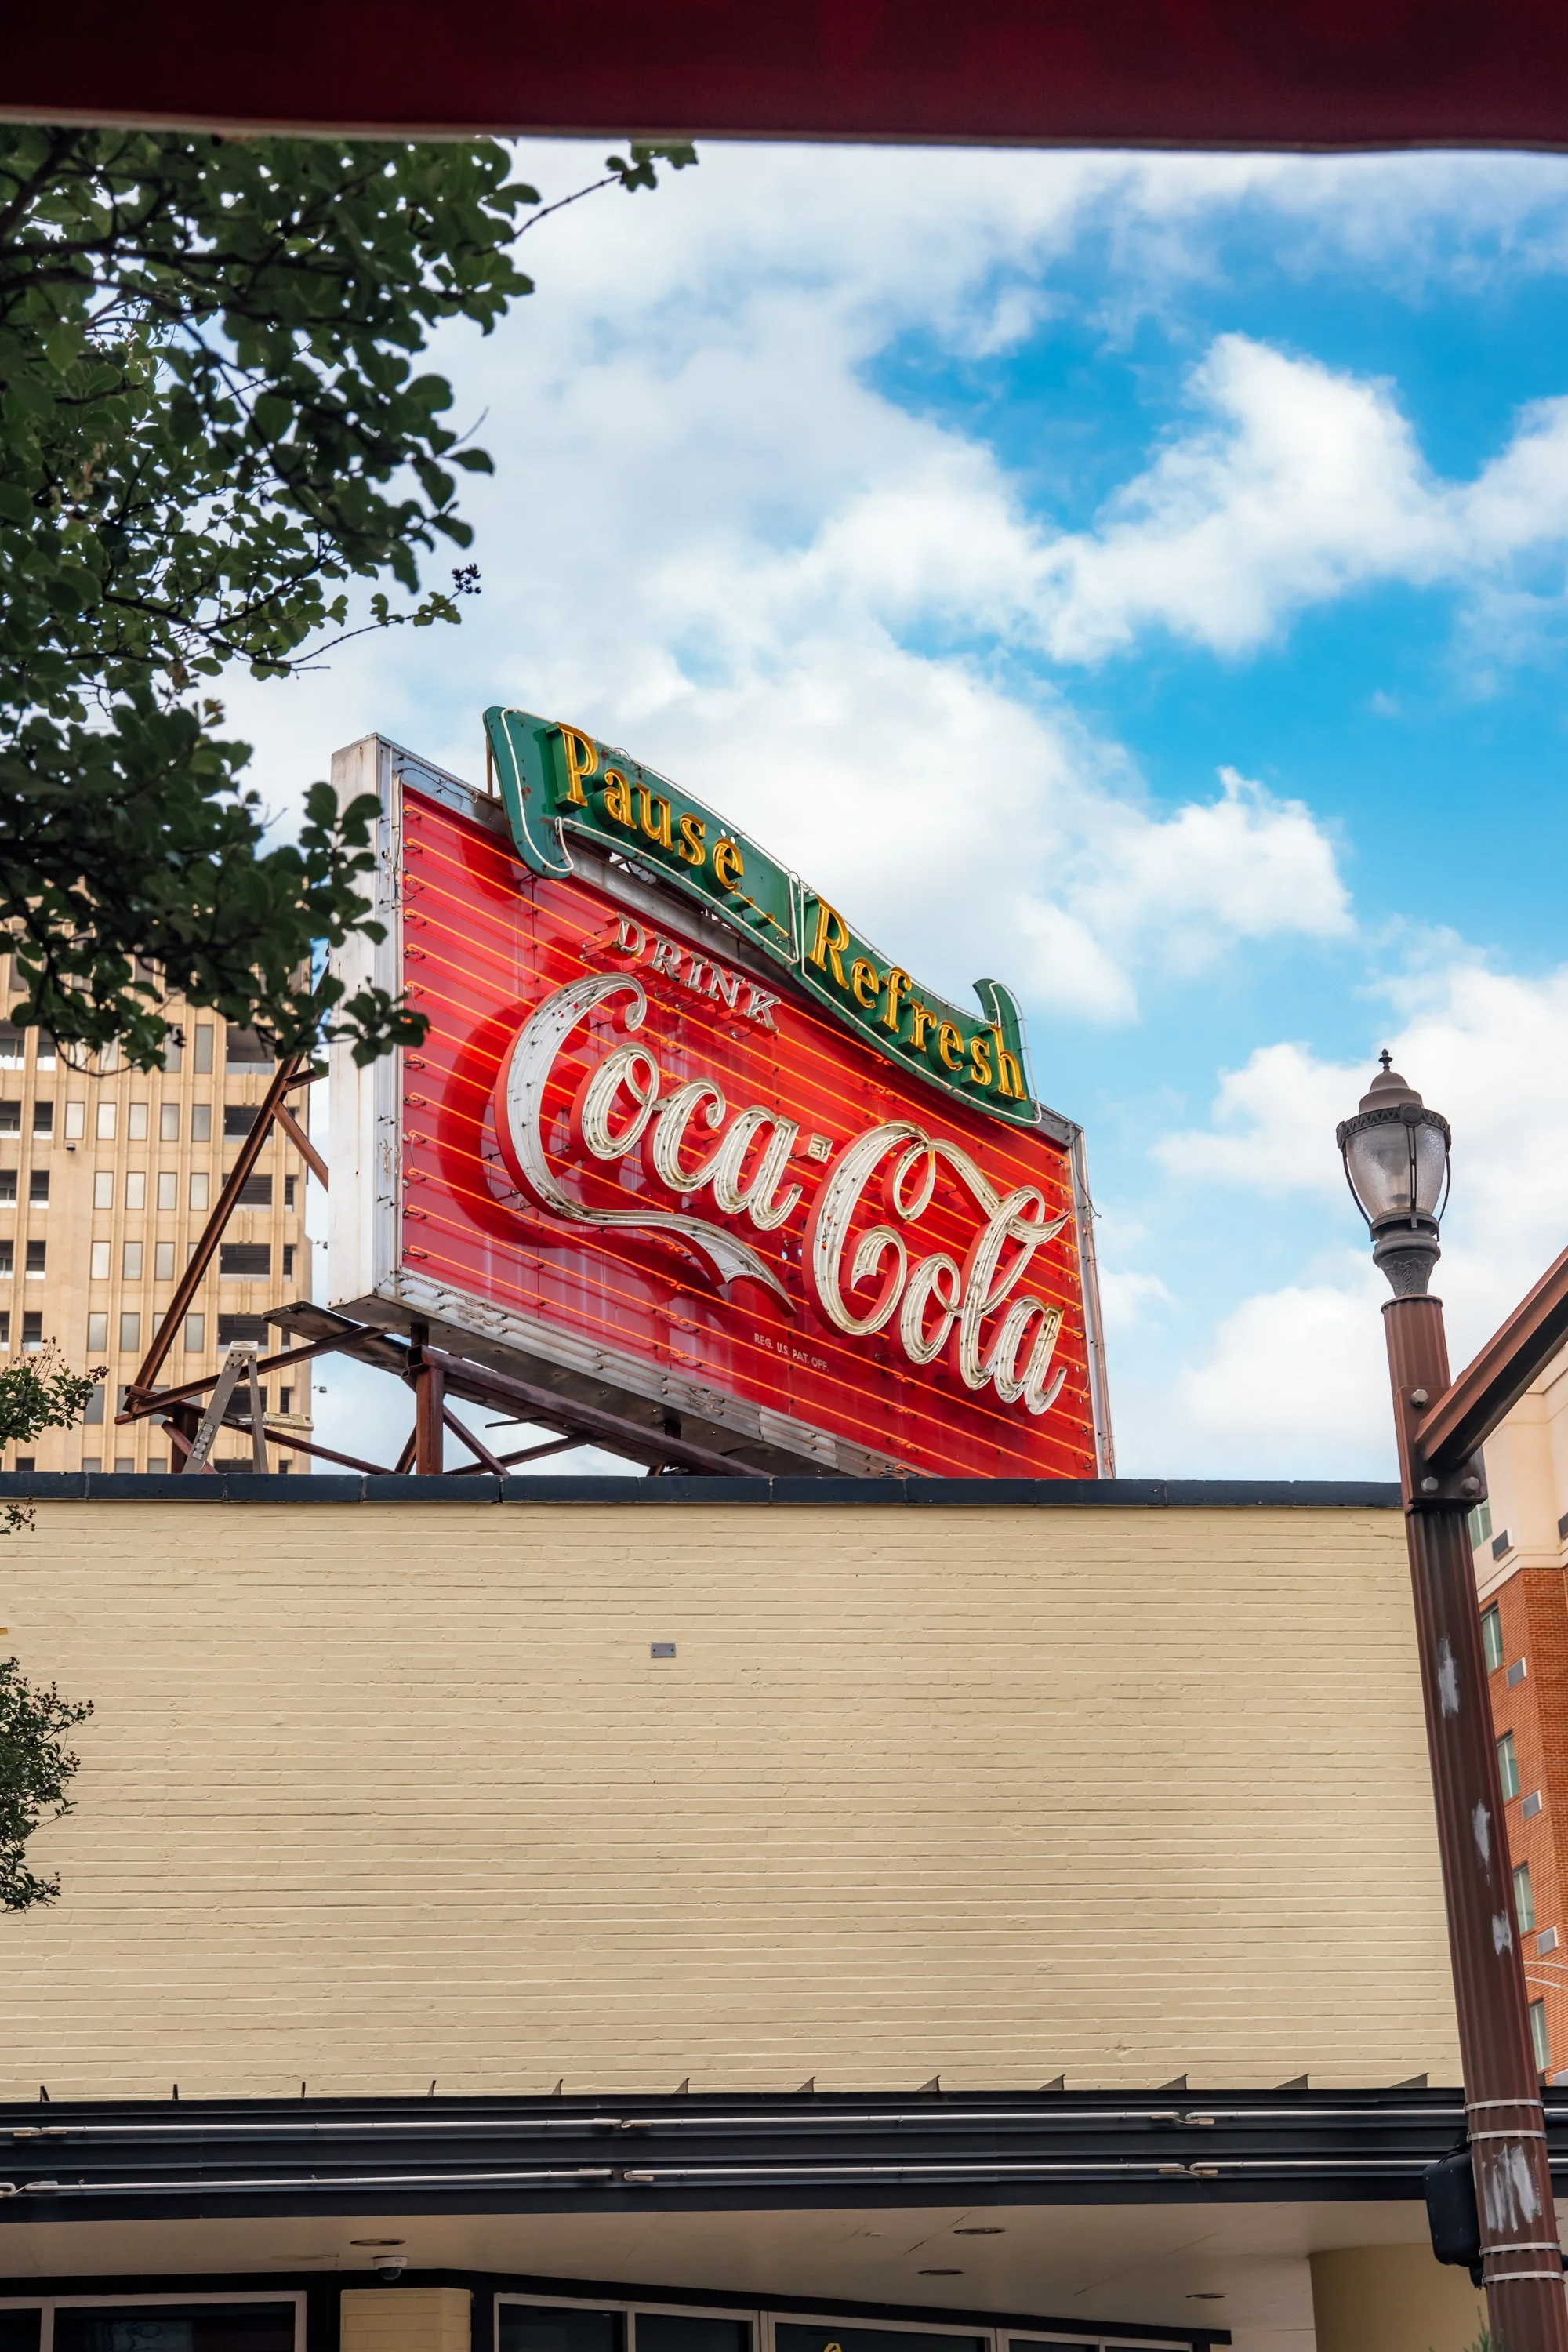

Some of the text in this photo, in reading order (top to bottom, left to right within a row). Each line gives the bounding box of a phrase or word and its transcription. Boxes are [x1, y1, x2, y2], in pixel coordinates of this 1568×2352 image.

[610, 911, 782, 1033] DRINK
[807, 894, 1028, 1102] Refresh
[502, 971, 1071, 1416] Coca-Cola
[753, 1332, 774, 1349] REG.
[792, 1348, 810, 1365] PAT.
[811, 1356, 829, 1373] OFF.
